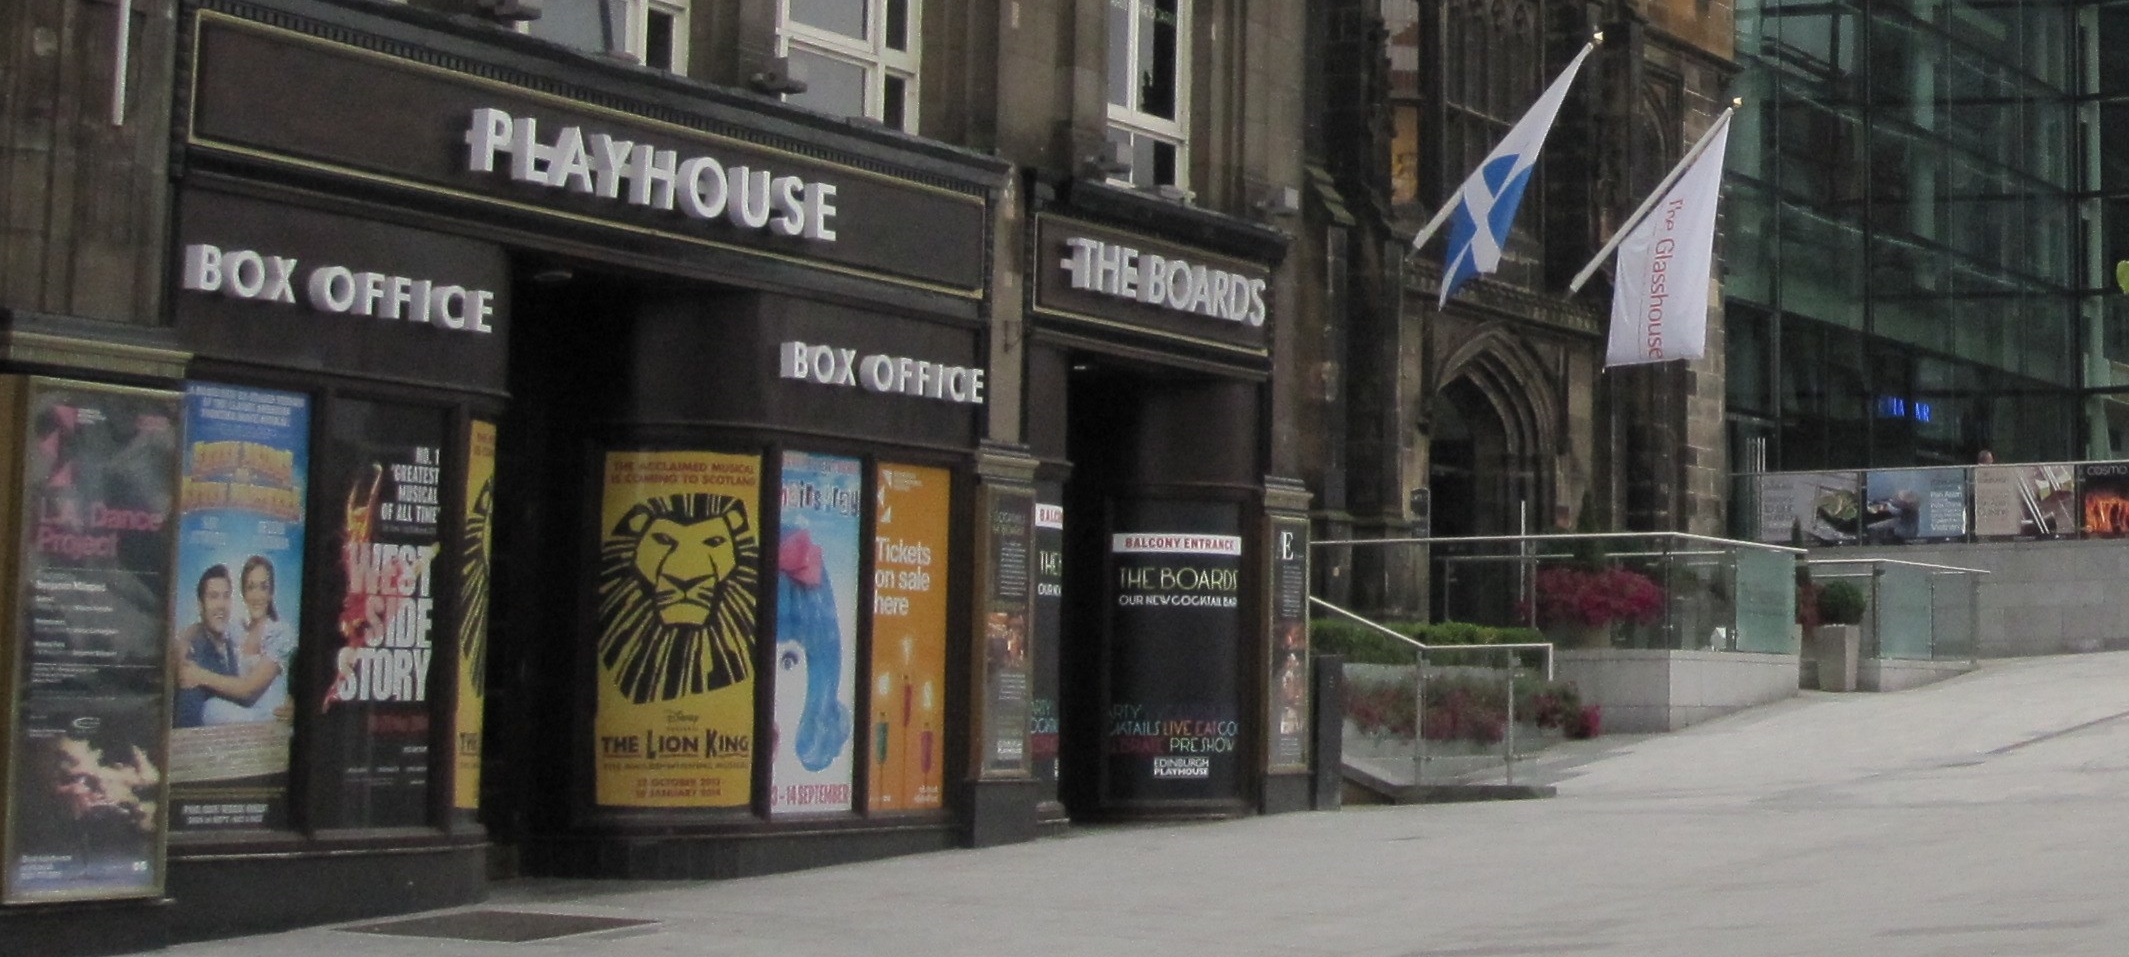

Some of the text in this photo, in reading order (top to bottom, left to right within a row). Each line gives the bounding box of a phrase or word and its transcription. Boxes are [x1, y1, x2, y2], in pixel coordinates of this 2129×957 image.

[465, 107, 837, 242] PLAYHOUSE
[183, 243, 494, 333] BOX OFFICE
[1060, 237, 1267, 327] THE BOARDS
[1648, 238, 1676, 360] Glasshouse
[780, 341, 984, 404] BOX OFFICE
[415, 447, 440, 465] NO. 1
[711, 462, 754, 474] MUSICAL
[684, 475, 698, 484] TO
[701, 475, 756, 486] SCOTLAND
[2087, 465, 2128, 476] cosmo
[399, 484, 438, 504] MUSICAL
[381, 502, 393, 521] OF
[396, 503, 413, 523] ALL
[876, 536, 931, 566] Tickets
[1125, 538, 1234, 551] BALCONY ENTRANCE
[349, 542, 433, 598] WEST
[874, 566, 930, 593] on sale
[1119, 566, 1239, 591] THE BOARDS
[873, 589, 909, 616] here
[1119, 595, 1144, 606] OUR
[1145, 595, 1170, 606] NEW
[1171, 595, 1221, 607] COCKTAIL
[364, 596, 434, 649] SIDE
[338, 646, 433, 701] STORY
[602, 736, 639, 753] THE
[1153, 758, 1209, 767] EDINBURGH
[1153, 767, 1209, 777] PLAYHOUSE
